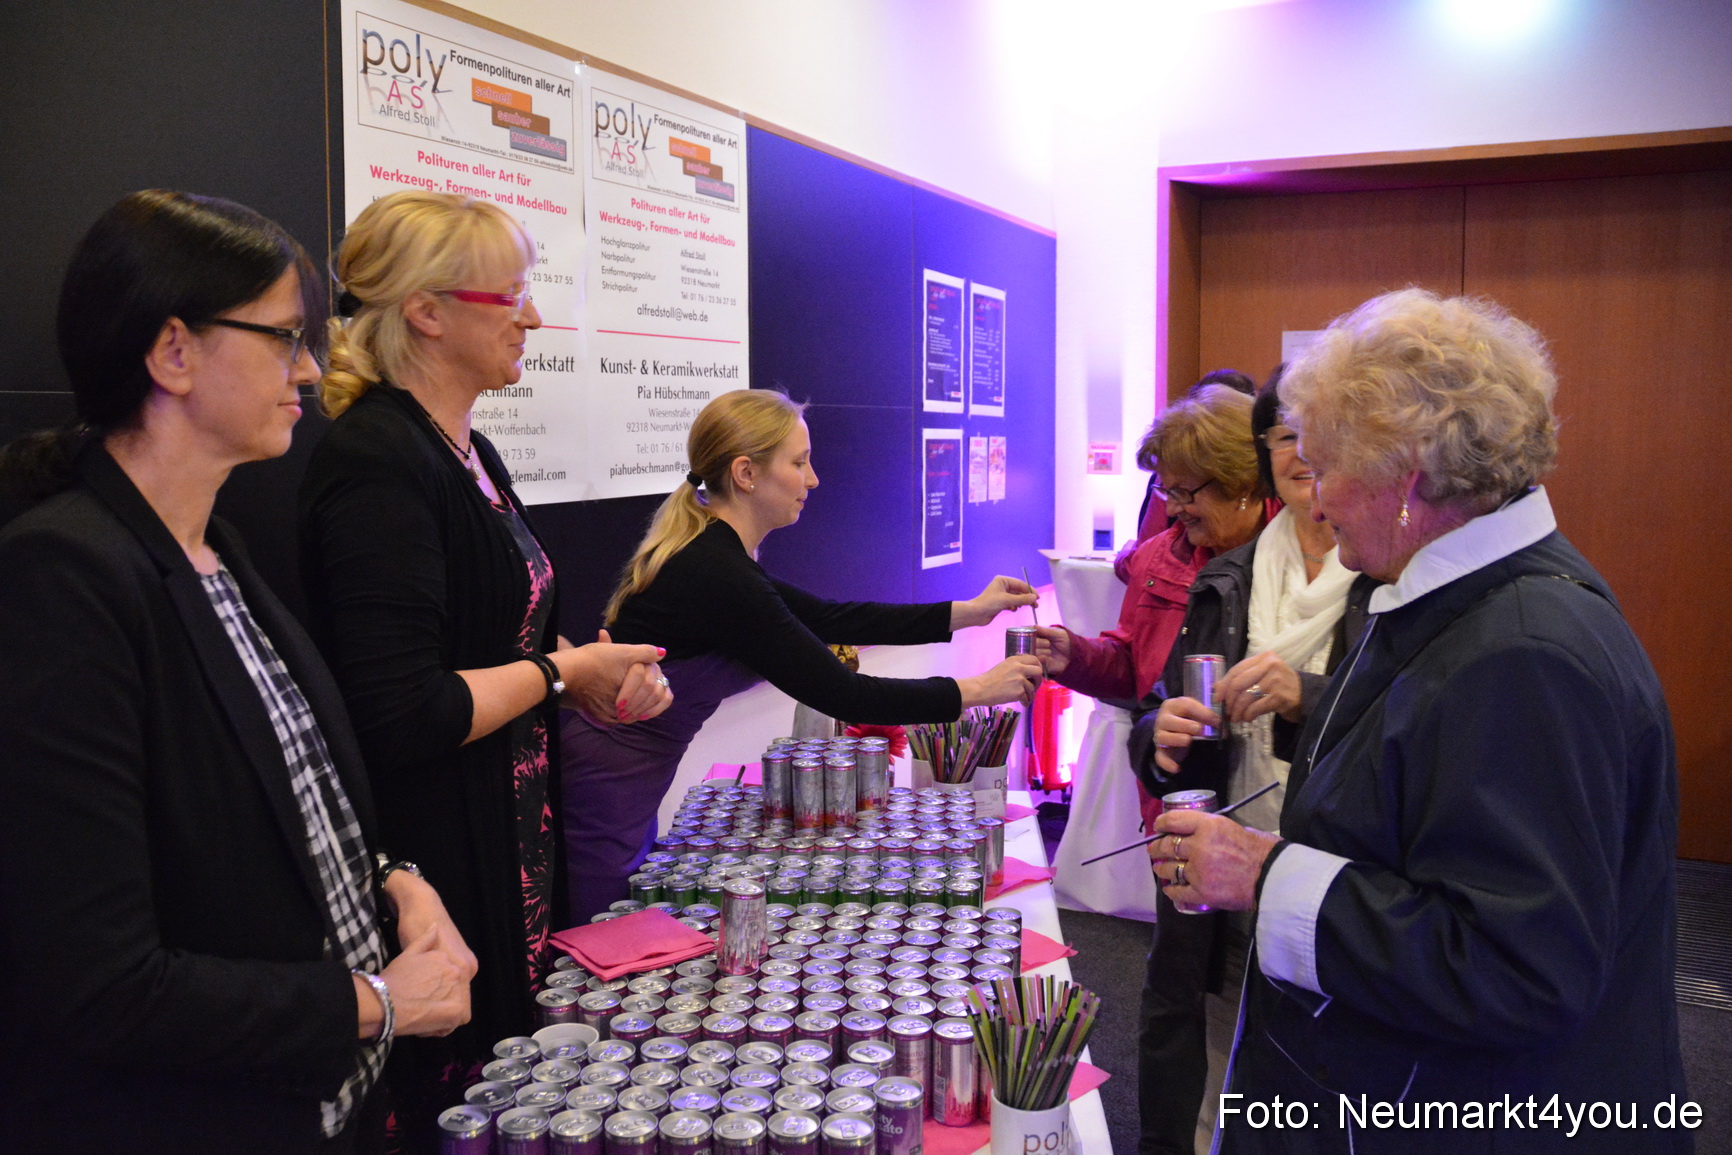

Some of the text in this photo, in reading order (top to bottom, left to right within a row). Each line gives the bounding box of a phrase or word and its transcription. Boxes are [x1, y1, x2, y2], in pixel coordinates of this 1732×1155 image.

[362, 28, 447, 93] poly
[450, 50, 571, 98] Formenpolituren aller Art
[475, 86, 513, 105] schnell
[379, 104, 435, 127] Alfred Stoll
[497, 110, 532, 128] sauber
[595, 101, 652, 151] poly
[654, 114, 738, 149] Formenpolituren aller Art
[511, 131, 566, 157] zuverlässig
[417, 150, 532, 187] Polituren aller Art für
[605, 160, 627, 176] Alfred
[370, 164, 568, 215] Werkzeug-, Formen- und Modellbau
[631, 197, 711, 224] Polituren aller Art für
[599, 210, 736, 247] Werkzeug-, Formen- und Modellbau
[601, 235, 651, 252] Hochglanzpolitur
[601, 251, 636, 264] Narbpolitur
[680, 249, 695, 260] Alfred
[532, 272, 542, 282] 23
[543, 273, 553, 283] 36
[553, 274, 563, 284] 27
[564, 275, 574, 285] 55
[601, 265, 657, 281] Entformungspolitur
[680, 264, 712, 277] Wiesenstraße
[602, 280, 638, 293] Strichpolitur
[681, 276, 721, 290] 92318 Neumarkt
[637, 304, 709, 322] alfredstoll@web.de
[600, 357, 739, 379] Kunst- & Keramikwerkstatt
[480, 385, 533, 398] schmann
[637, 385, 710, 400] Pia Hübschmann
[472, 407, 519, 420] nstraße 14
[648, 407, 691, 418] Wiesenstraße
[475, 423, 546, 437] arkt-Woffenbach
[626, 421, 691, 433] 92318 Neumarkt-W
[511, 448, 523, 461] 73
[525, 447, 536, 460] 59
[636, 443, 649, 455] Tel:
[650, 443, 659, 454] 01
[661, 442, 670, 453] 76
[675, 442, 683, 453] 61
[510, 468, 567, 486] glemail.com
[610, 460, 691, 479] piahuebschmann@go
